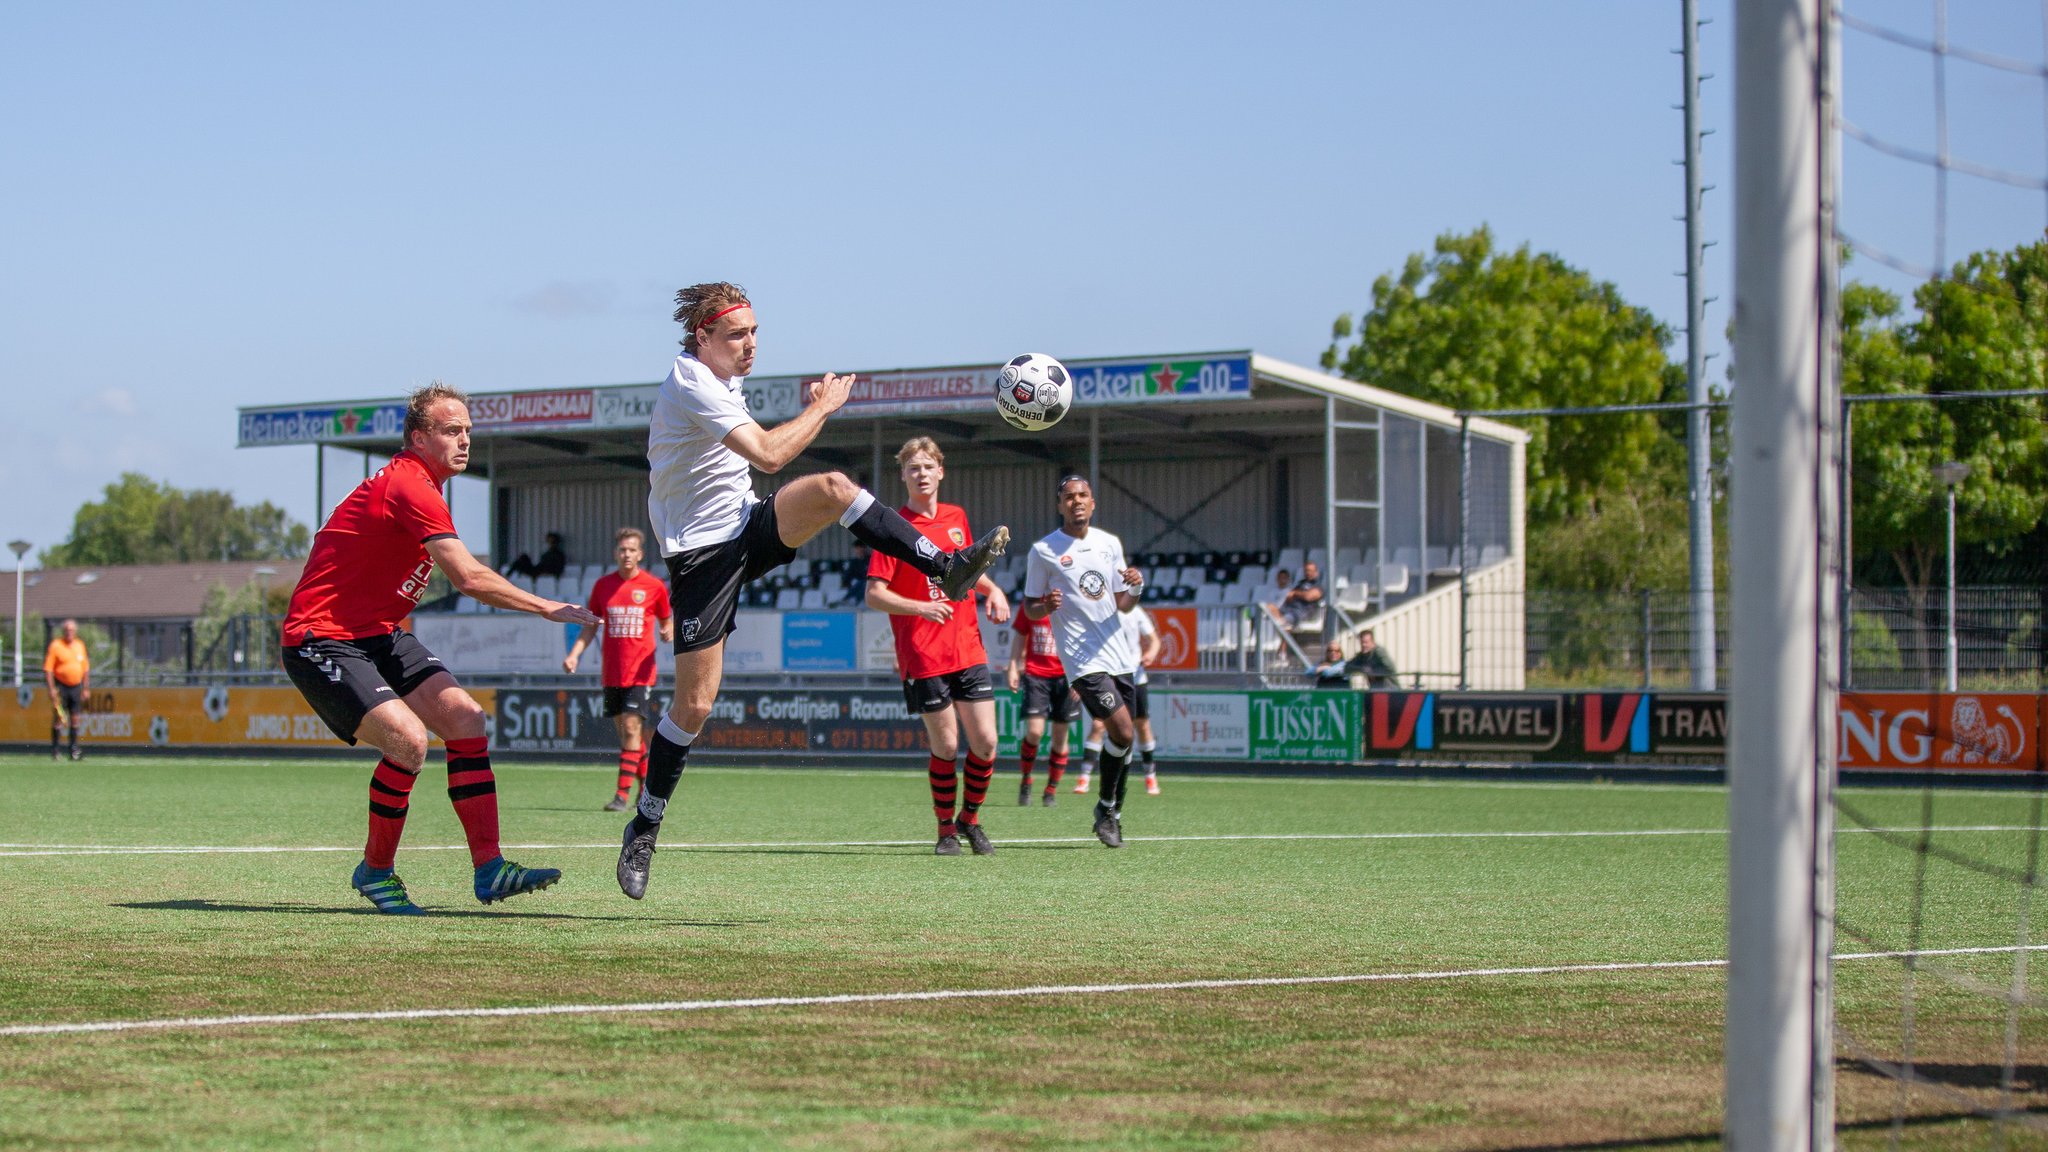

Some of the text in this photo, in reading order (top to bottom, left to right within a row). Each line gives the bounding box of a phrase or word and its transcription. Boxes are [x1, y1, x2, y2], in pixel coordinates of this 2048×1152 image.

[875, 375, 974, 397] TWEEWIELERS
[514, 393, 592, 419] HUISMAN
[998, 395, 1043, 421] DERBYSTAR
[241, 408, 336, 441] Heineken
[607, 607, 645, 615] VAN DER
[608, 616, 644, 625] LINDEN
[609, 626, 643, 635] GROEP
[504, 690, 581, 738] Smit
[758, 696, 840, 724] Gordijnen
[1171, 697, 1232, 719] NATURAL
[246, 715, 290, 739] JUMBO
[1191, 720, 1244, 742] HEALTH
[1253, 698, 1347, 744] TIJSSEN
[1439, 707, 1551, 736] TRAVEL
[1656, 708, 1730, 738] TRAV
[831, 731, 858, 748] 071
[863, 731, 889, 748] 512
[1839, 709, 1934, 764] NG
[1255, 744, 1280, 760] goed
[1284, 747, 1309, 757] voor
[1312, 745, 1347, 758] dieren
